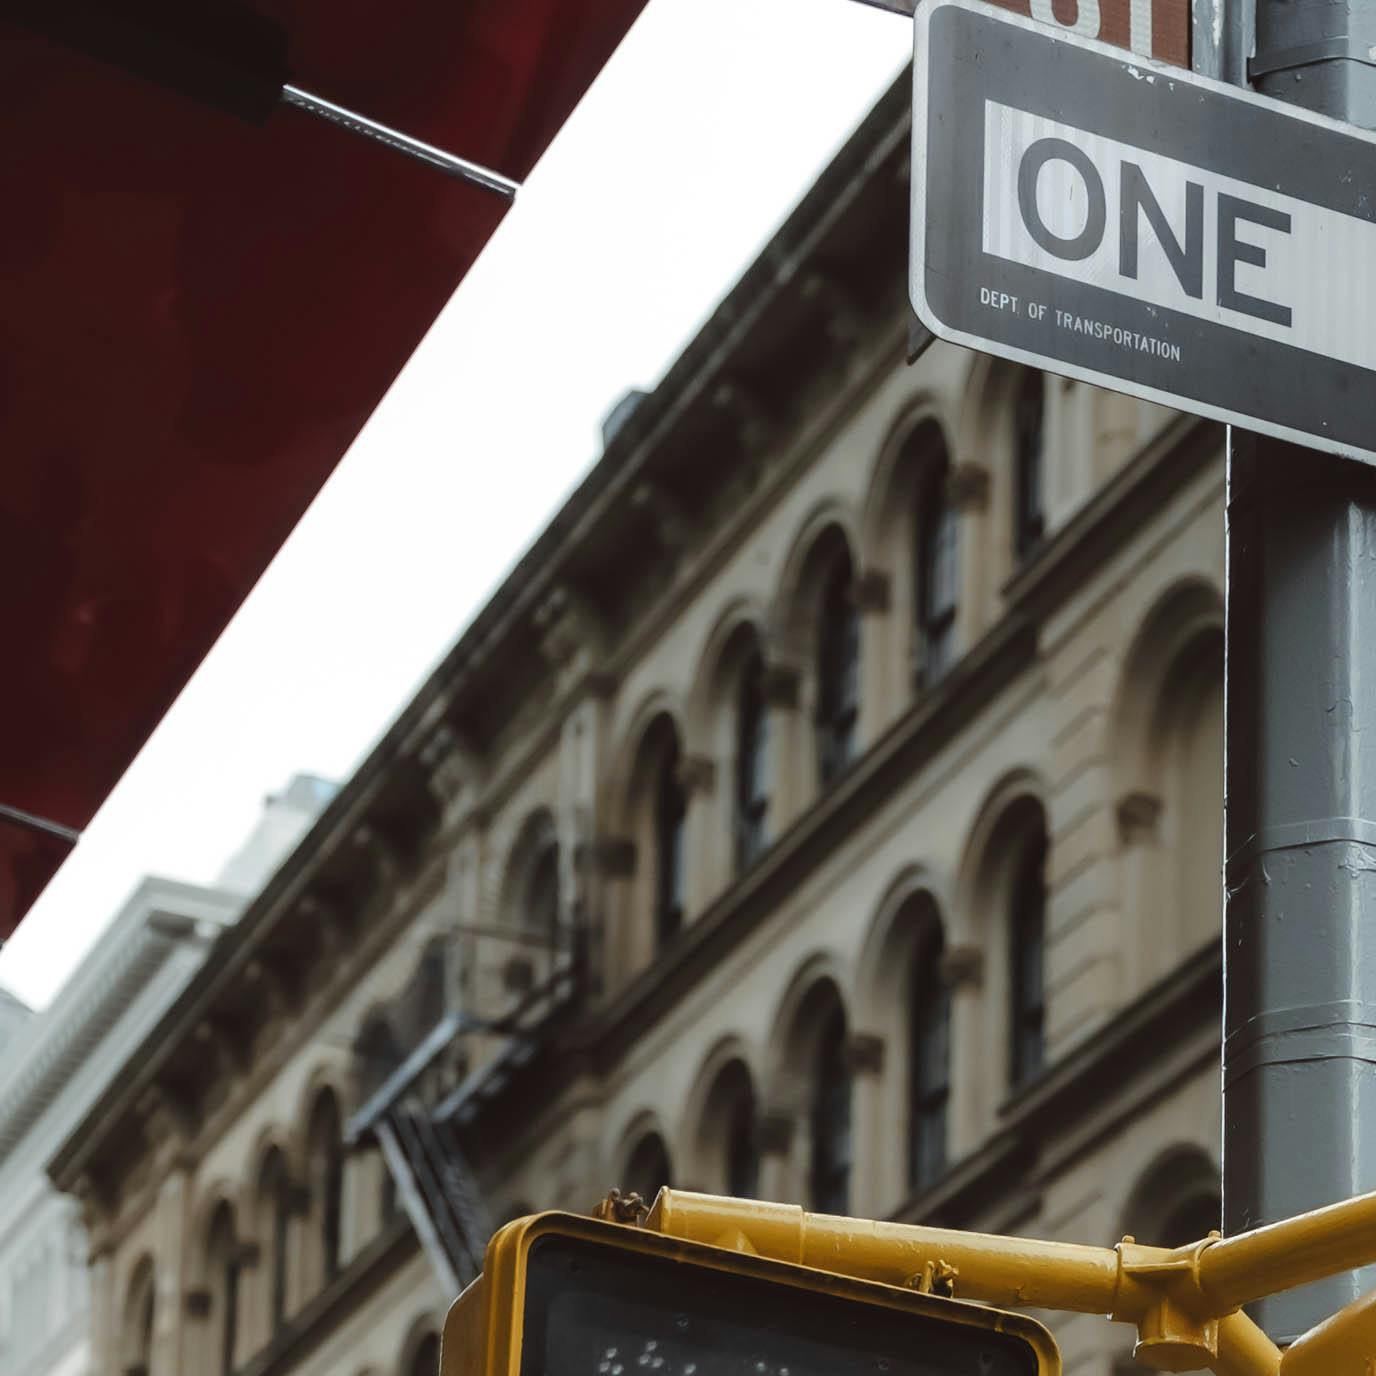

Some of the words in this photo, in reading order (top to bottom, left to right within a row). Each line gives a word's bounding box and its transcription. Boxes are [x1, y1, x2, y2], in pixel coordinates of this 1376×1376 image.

[1017, 137, 1292, 328] ONE
[1028, 302, 1047, 321] OF
[1056, 309, 1181, 362] TRANSPORTATION
